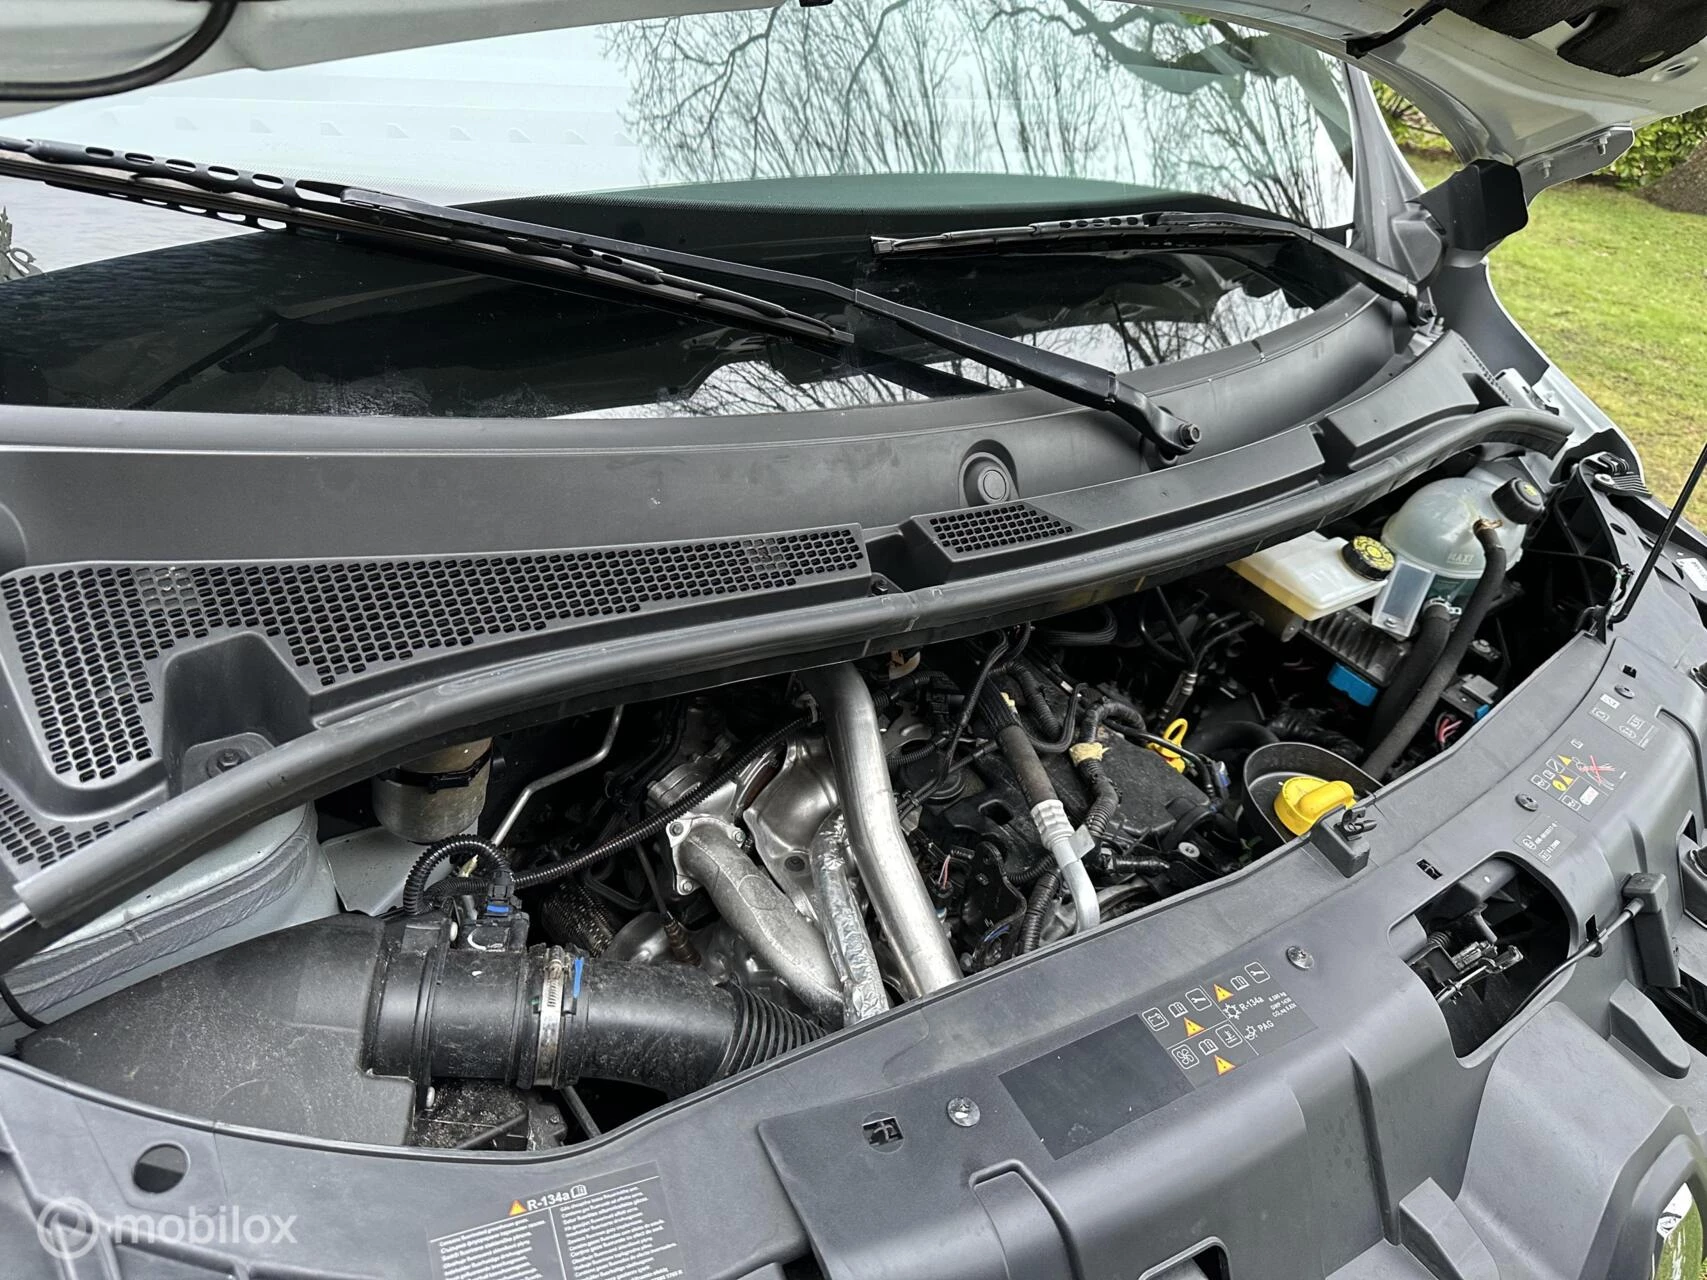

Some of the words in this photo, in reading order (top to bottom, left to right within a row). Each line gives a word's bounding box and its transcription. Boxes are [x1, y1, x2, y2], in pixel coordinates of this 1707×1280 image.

[1239, 996, 1264, 1011] R-134a
[1257, 1020, 1274, 1033] PAG
[526, 1190, 571, 1212] R-134a
